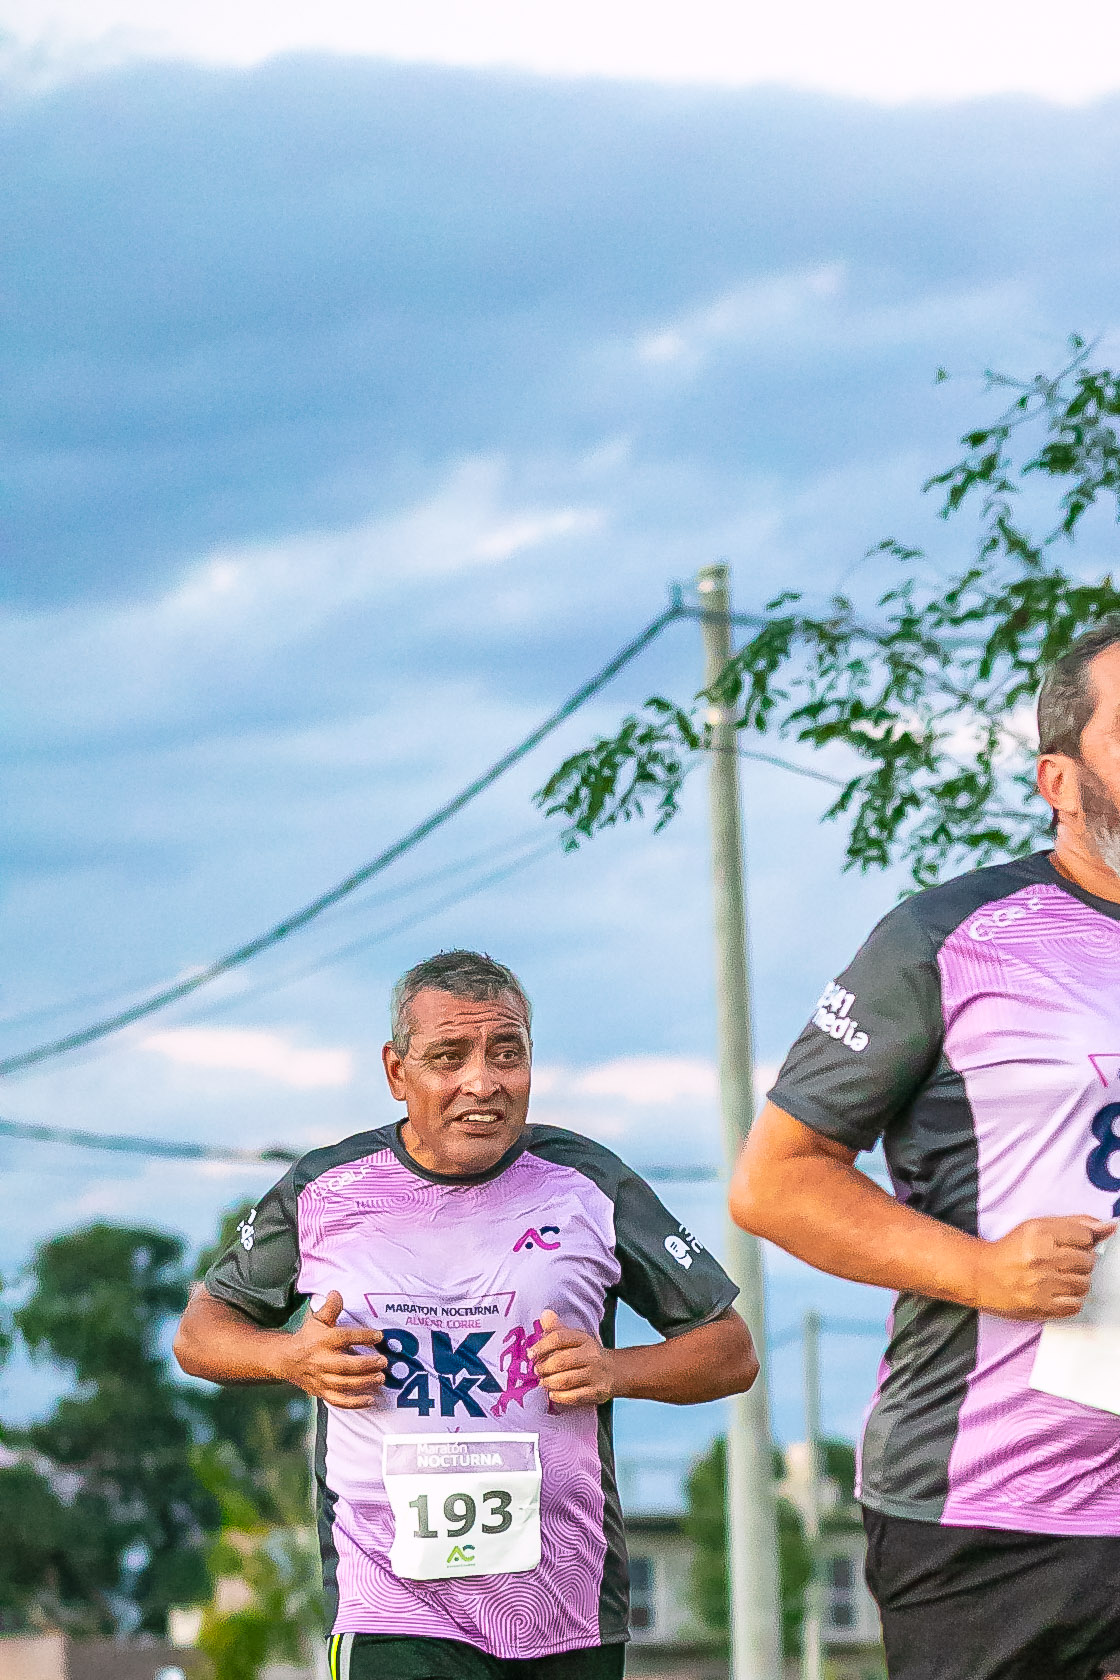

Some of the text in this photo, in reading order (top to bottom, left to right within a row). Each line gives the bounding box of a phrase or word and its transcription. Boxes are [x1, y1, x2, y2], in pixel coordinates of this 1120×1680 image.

[385, 1304, 500, 1316] MARATON NOCTURNA
[374, 1328, 504, 1393] 8K
[396, 1372, 488, 1418] 4K
[416, 1453, 503, 1468] NOCTURNA
[417, 1442, 468, 1455] Maratón
[408, 1490, 513, 1539] 193
